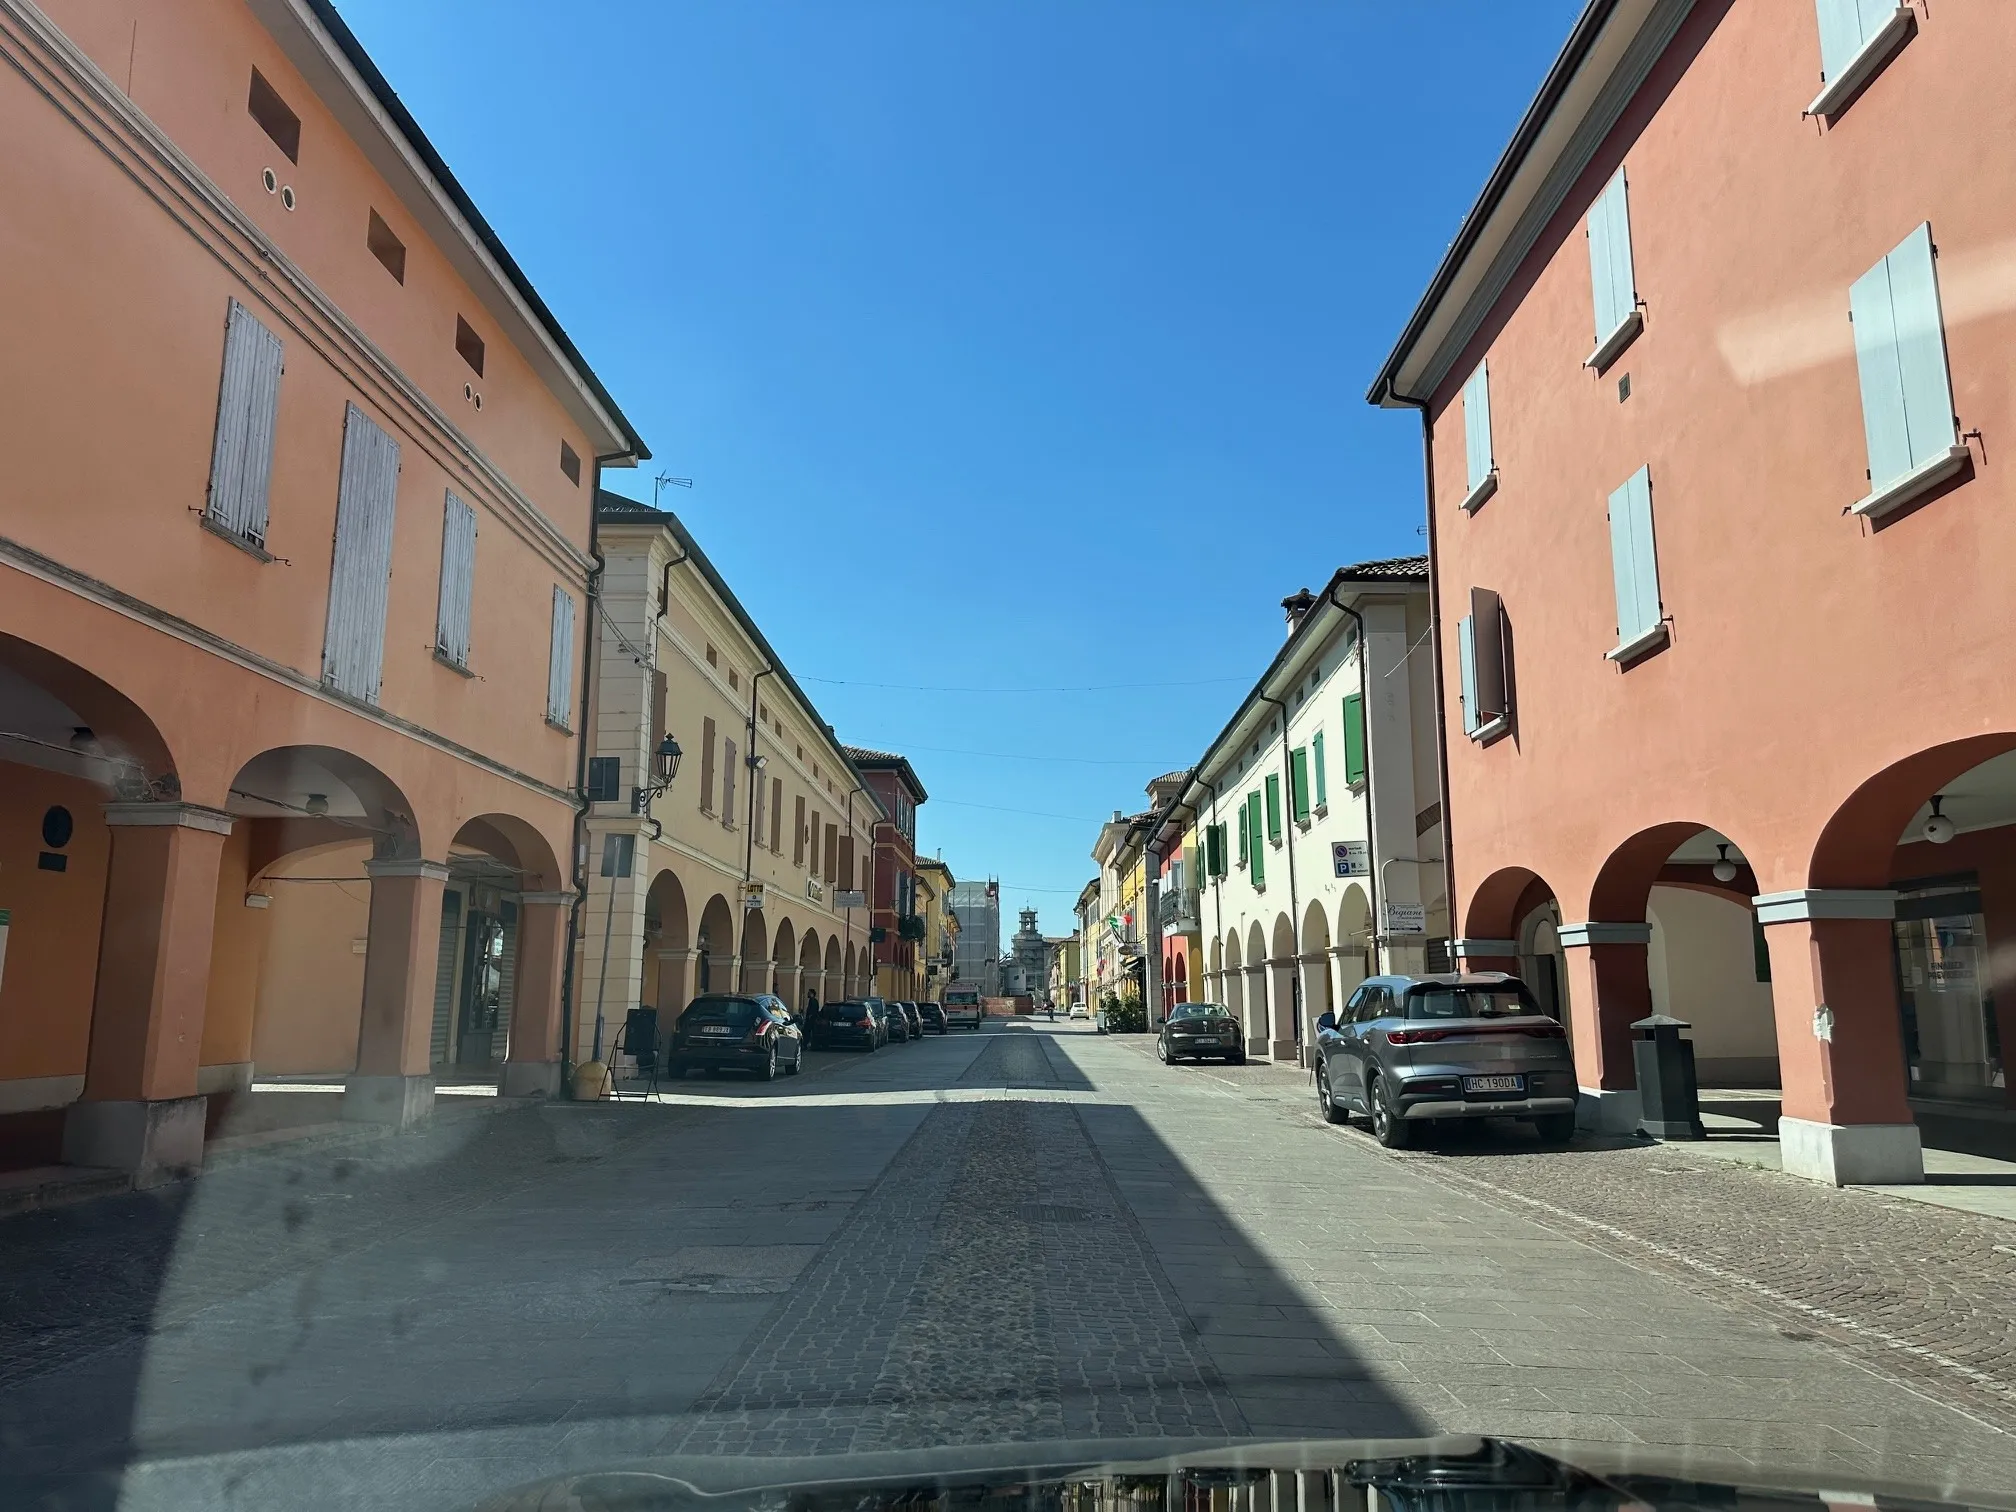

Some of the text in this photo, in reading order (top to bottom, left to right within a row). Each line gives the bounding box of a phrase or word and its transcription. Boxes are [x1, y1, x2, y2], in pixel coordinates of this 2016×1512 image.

[747, 884, 764, 893] LOTTO
[1471, 1077, 1517, 1089] HC 190DA
